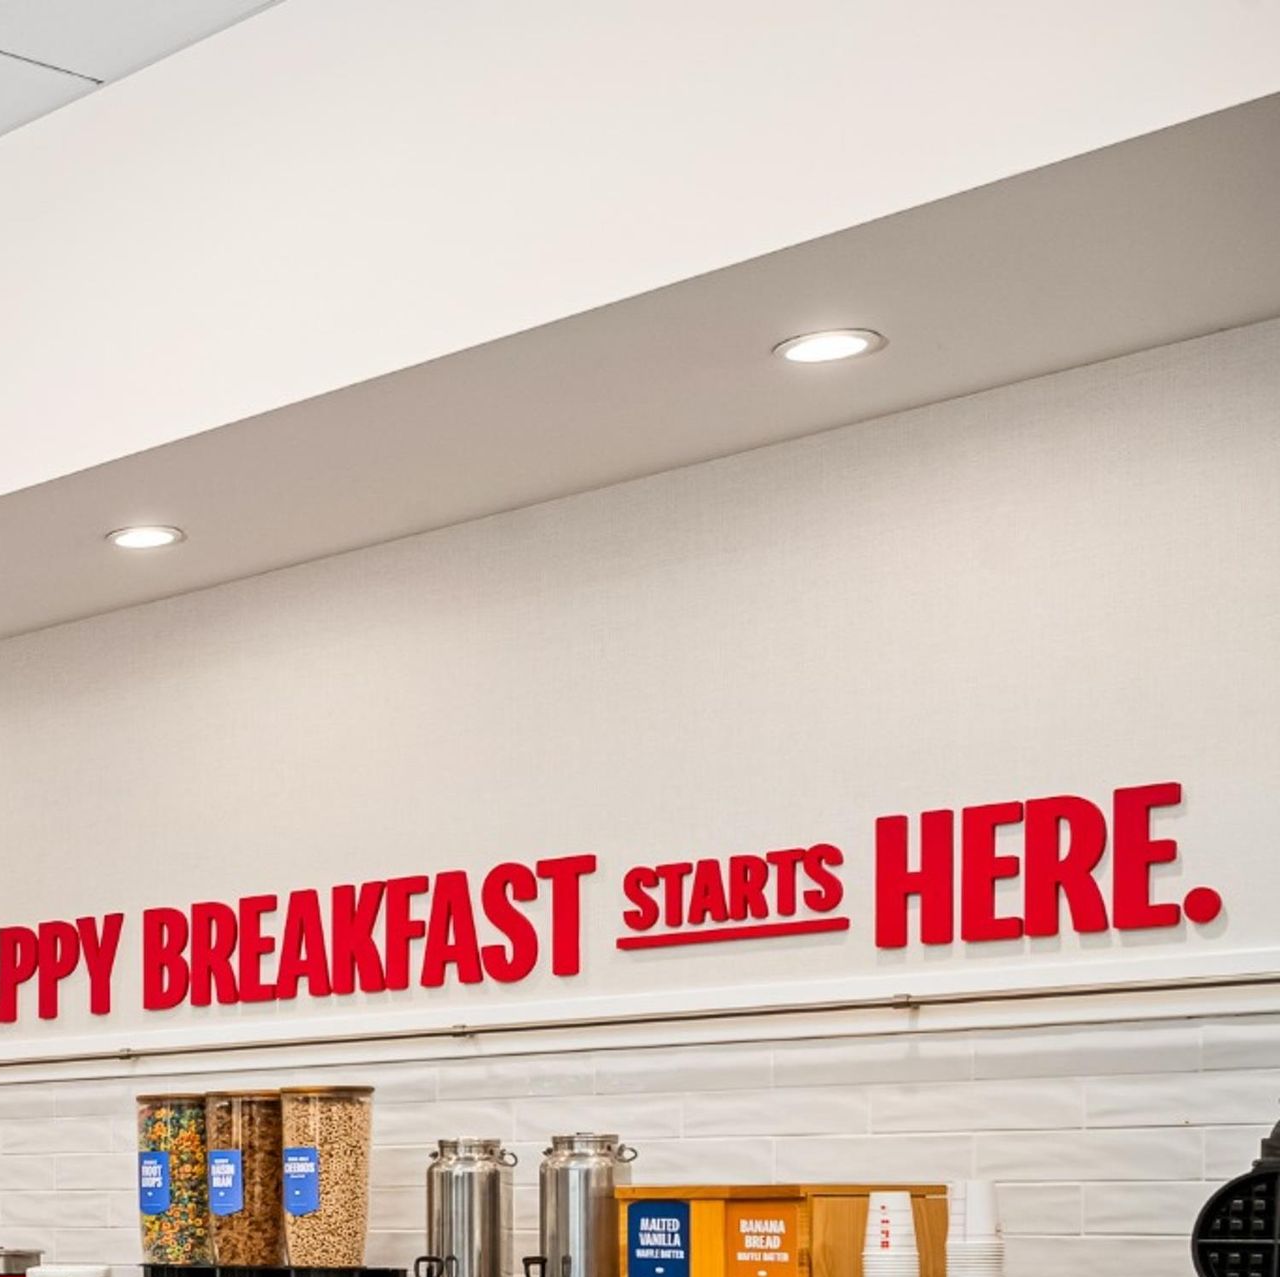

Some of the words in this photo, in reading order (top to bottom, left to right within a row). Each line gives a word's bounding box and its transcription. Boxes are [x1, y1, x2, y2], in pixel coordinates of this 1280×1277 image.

[142, 854, 598, 1011] BREAKFAST
[621, 843, 845, 931] STARTS
[874, 782, 1224, 949] HERE.
[640, 1217, 681, 1232] MALTED
[740, 1219, 786, 1234] BANANA
[638, 1232, 682, 1248] VANILLA
[744, 1235, 781, 1250] BREAD
